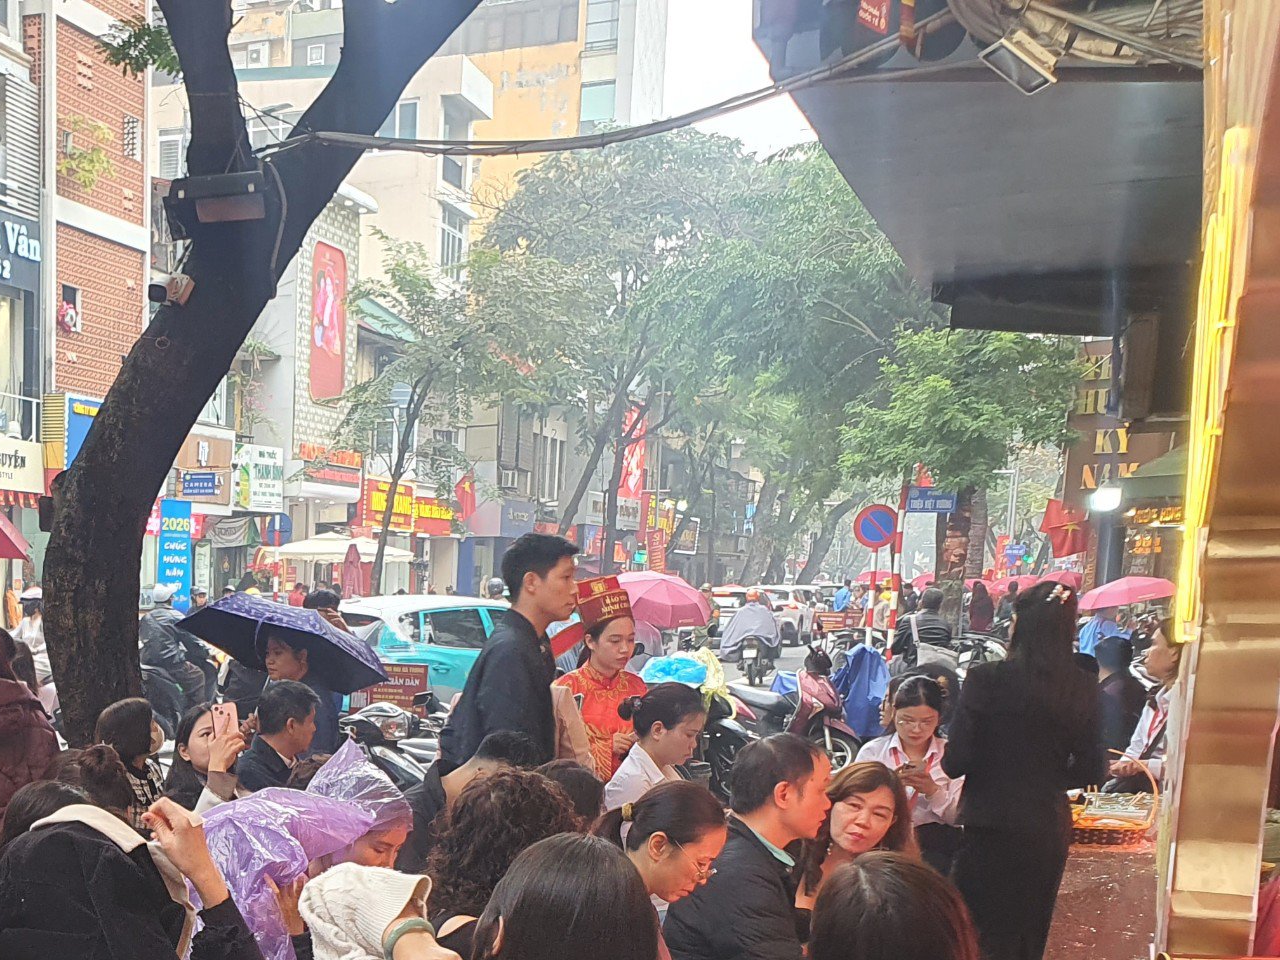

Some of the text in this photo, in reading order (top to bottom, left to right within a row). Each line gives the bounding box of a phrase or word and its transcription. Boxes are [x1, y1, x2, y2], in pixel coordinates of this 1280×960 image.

[4, 221, 41, 262] Vân
[2, 259, 11, 279] 2
[162, 517, 190, 531] 2026
[164, 540, 187, 550] CHÚC
